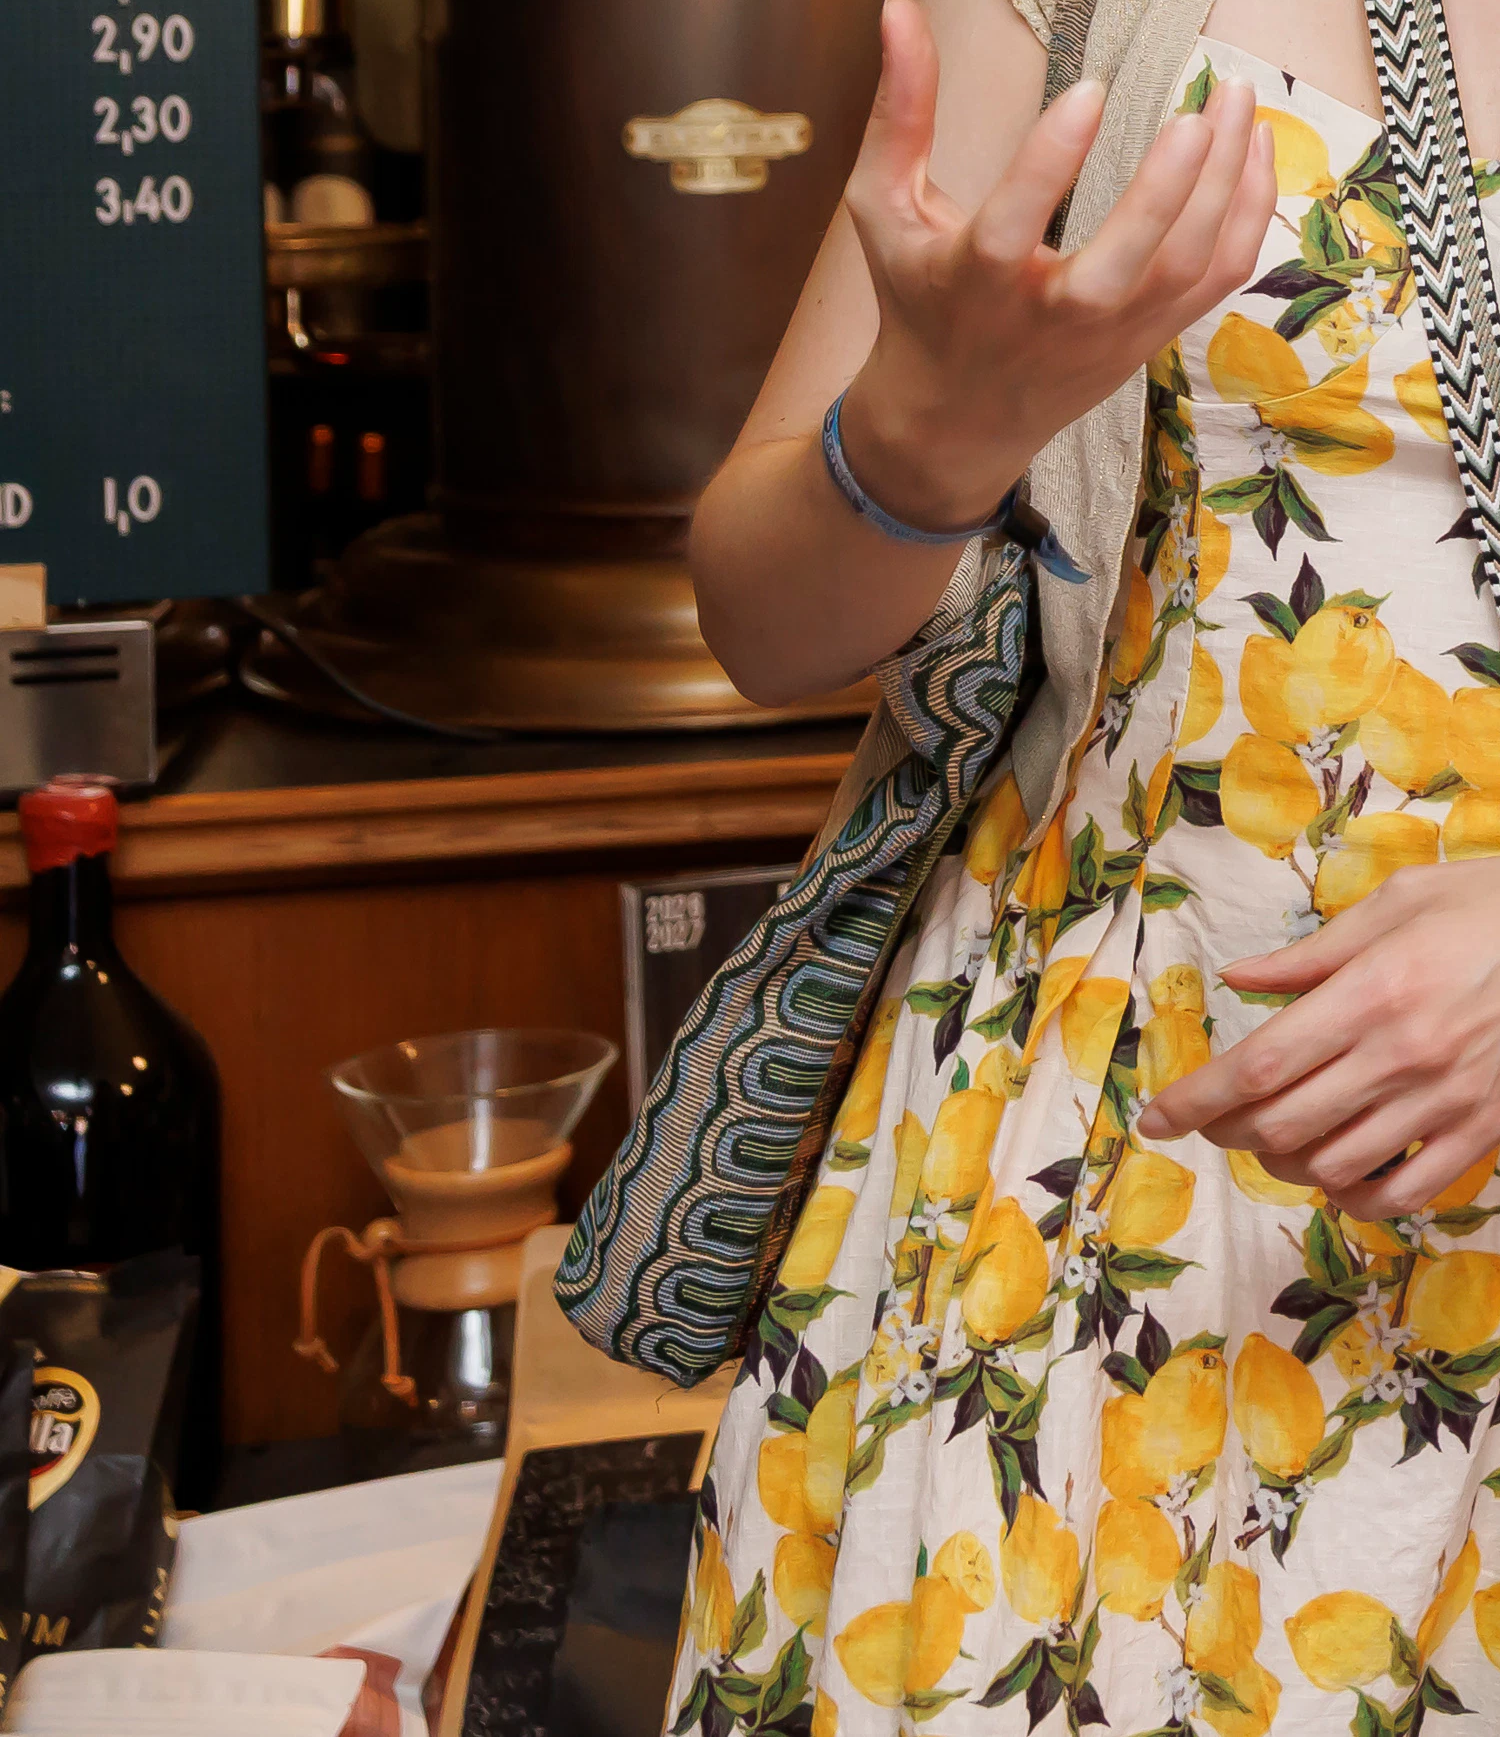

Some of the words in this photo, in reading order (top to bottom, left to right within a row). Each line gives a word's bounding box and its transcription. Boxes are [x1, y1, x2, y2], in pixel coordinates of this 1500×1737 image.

[92, 13, 194, 74] 2,90
[93, 95, 192, 156] 2,30
[95, 174, 194, 227] 3,40
